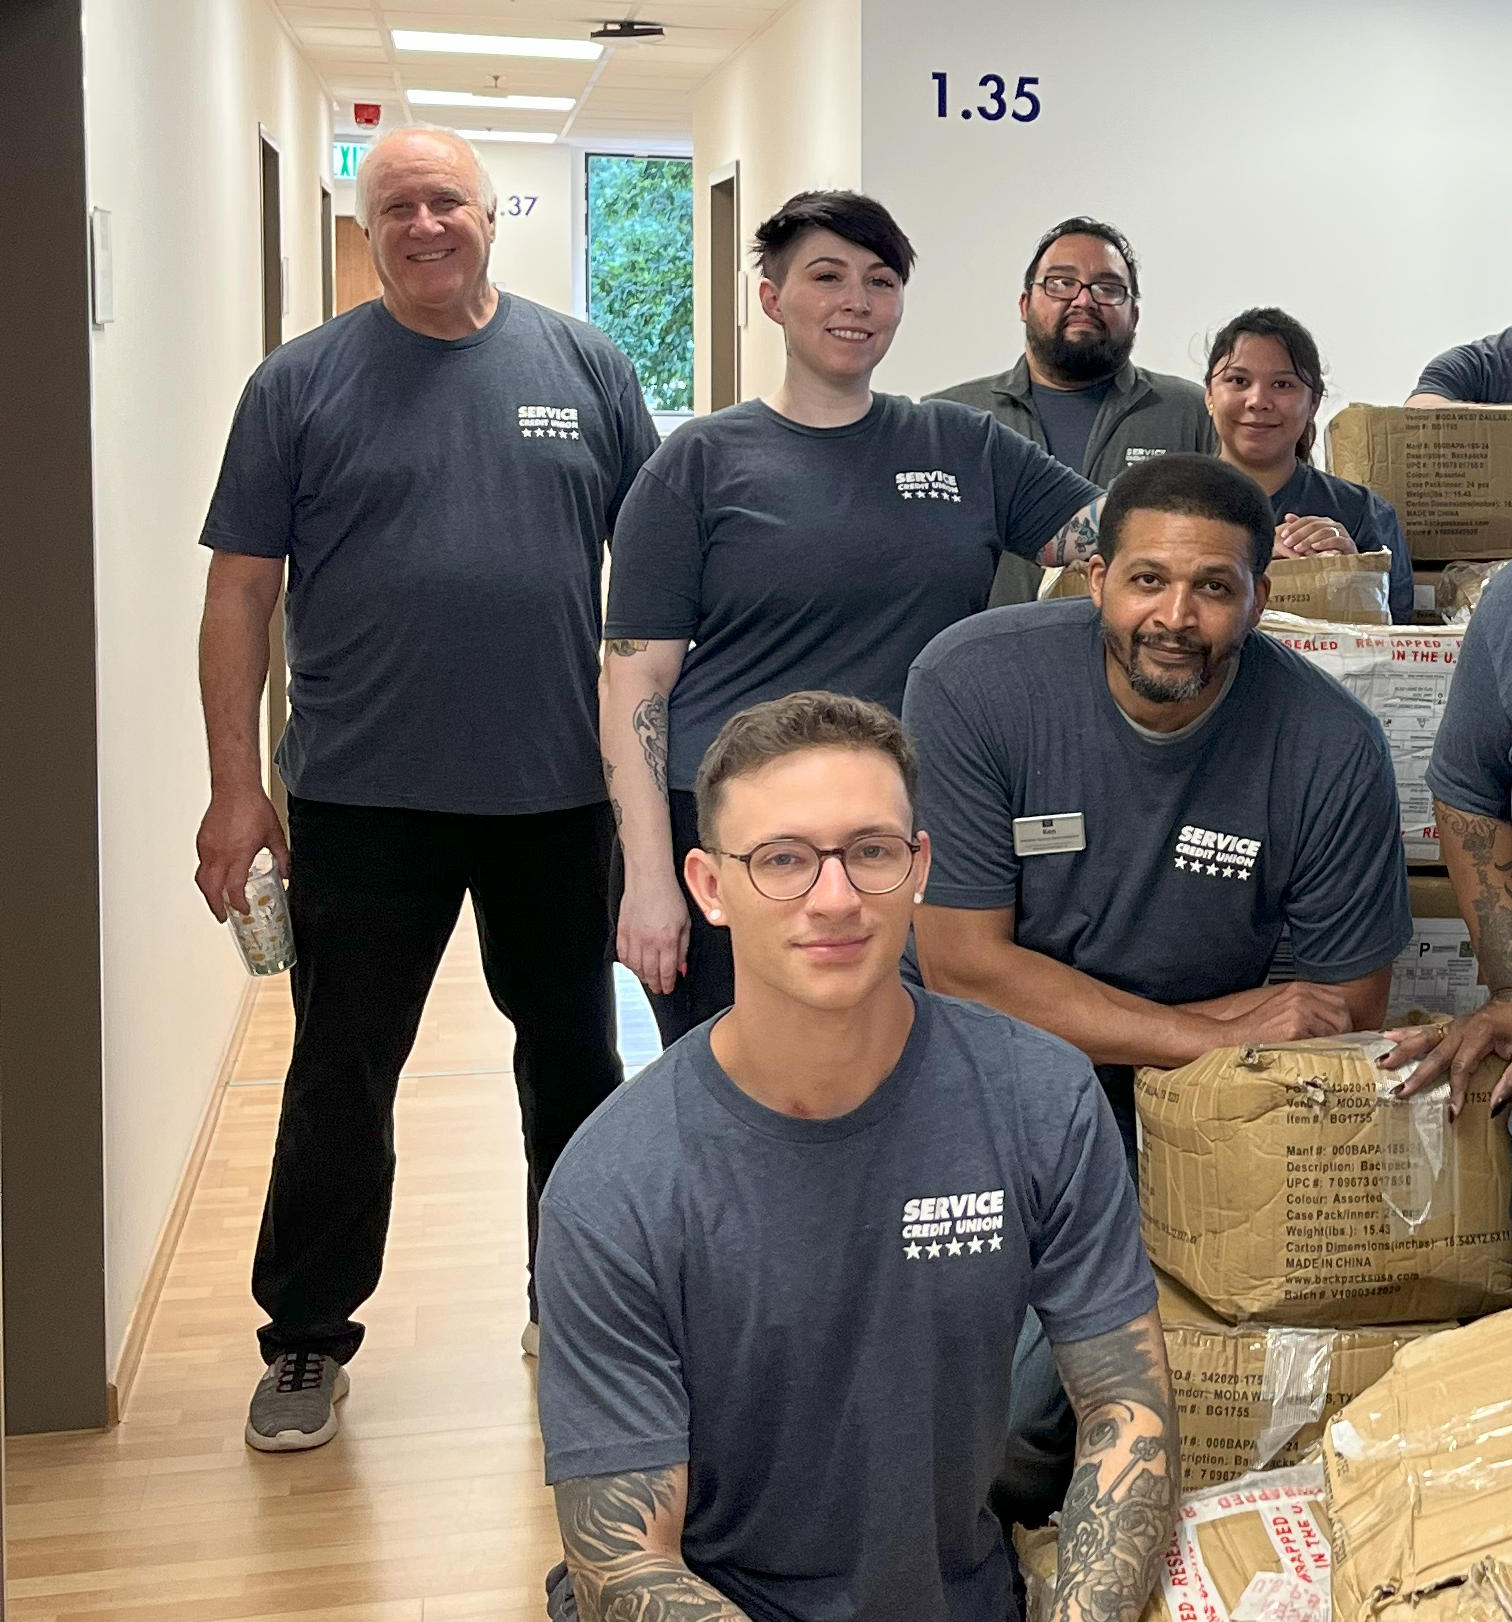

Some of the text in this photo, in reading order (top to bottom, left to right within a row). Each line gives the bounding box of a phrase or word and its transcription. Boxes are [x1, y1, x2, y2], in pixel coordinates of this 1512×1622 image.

[931, 71, 1041, 123] 1.35
[333, 146, 369, 176] XI
[500, 195, 539, 216] .37
[517, 405, 578, 421] SERVICE
[519, 418, 579, 429] CREDIT UNION
[895, 469, 957, 486] SERVICE
[897, 480, 959, 493] CREDIT UNION
[1281, 638, 1339, 651] SEALED
[1391, 649, 1439, 662] IN THE
[1178, 824, 1262, 857] SERVICE
[1175, 842, 1255, 868] CREDIT UNION
[1336, 1098, 1372, 1109] MODA
[1286, 1113, 1373, 1125] Item BG1755
[1286, 1145, 1314, 1156] Manf
[1286, 1161, 1355, 1175] Description:
[1286, 1177, 1311, 1189] UPC
[1286, 1192, 1384, 1205] Colour: Assorted
[901, 1189, 1005, 1223] SERVICE
[1286, 1208, 1380, 1221] Case Pack/Inner:
[901, 1214, 1004, 1240] CREDIT UNION
[1285, 1224, 1391, 1238] Weight(lbs.): 15.43
[1286, 1238, 1439, 1254] Carton Dimensions(inches):
[1285, 1256, 1372, 1269] MADE IN CHINA
[1285, 1272, 1420, 1286] www.backpacksusa.com
[1285, 1289, 1318, 1301] Batch
[1330, 1286, 1401, 1300] V1000342020
[1173, 1387, 1249, 1401] endor: MODA
[1205, 1405, 1250, 1418] BG1755
[1296, 1519, 1321, 1548] THE
